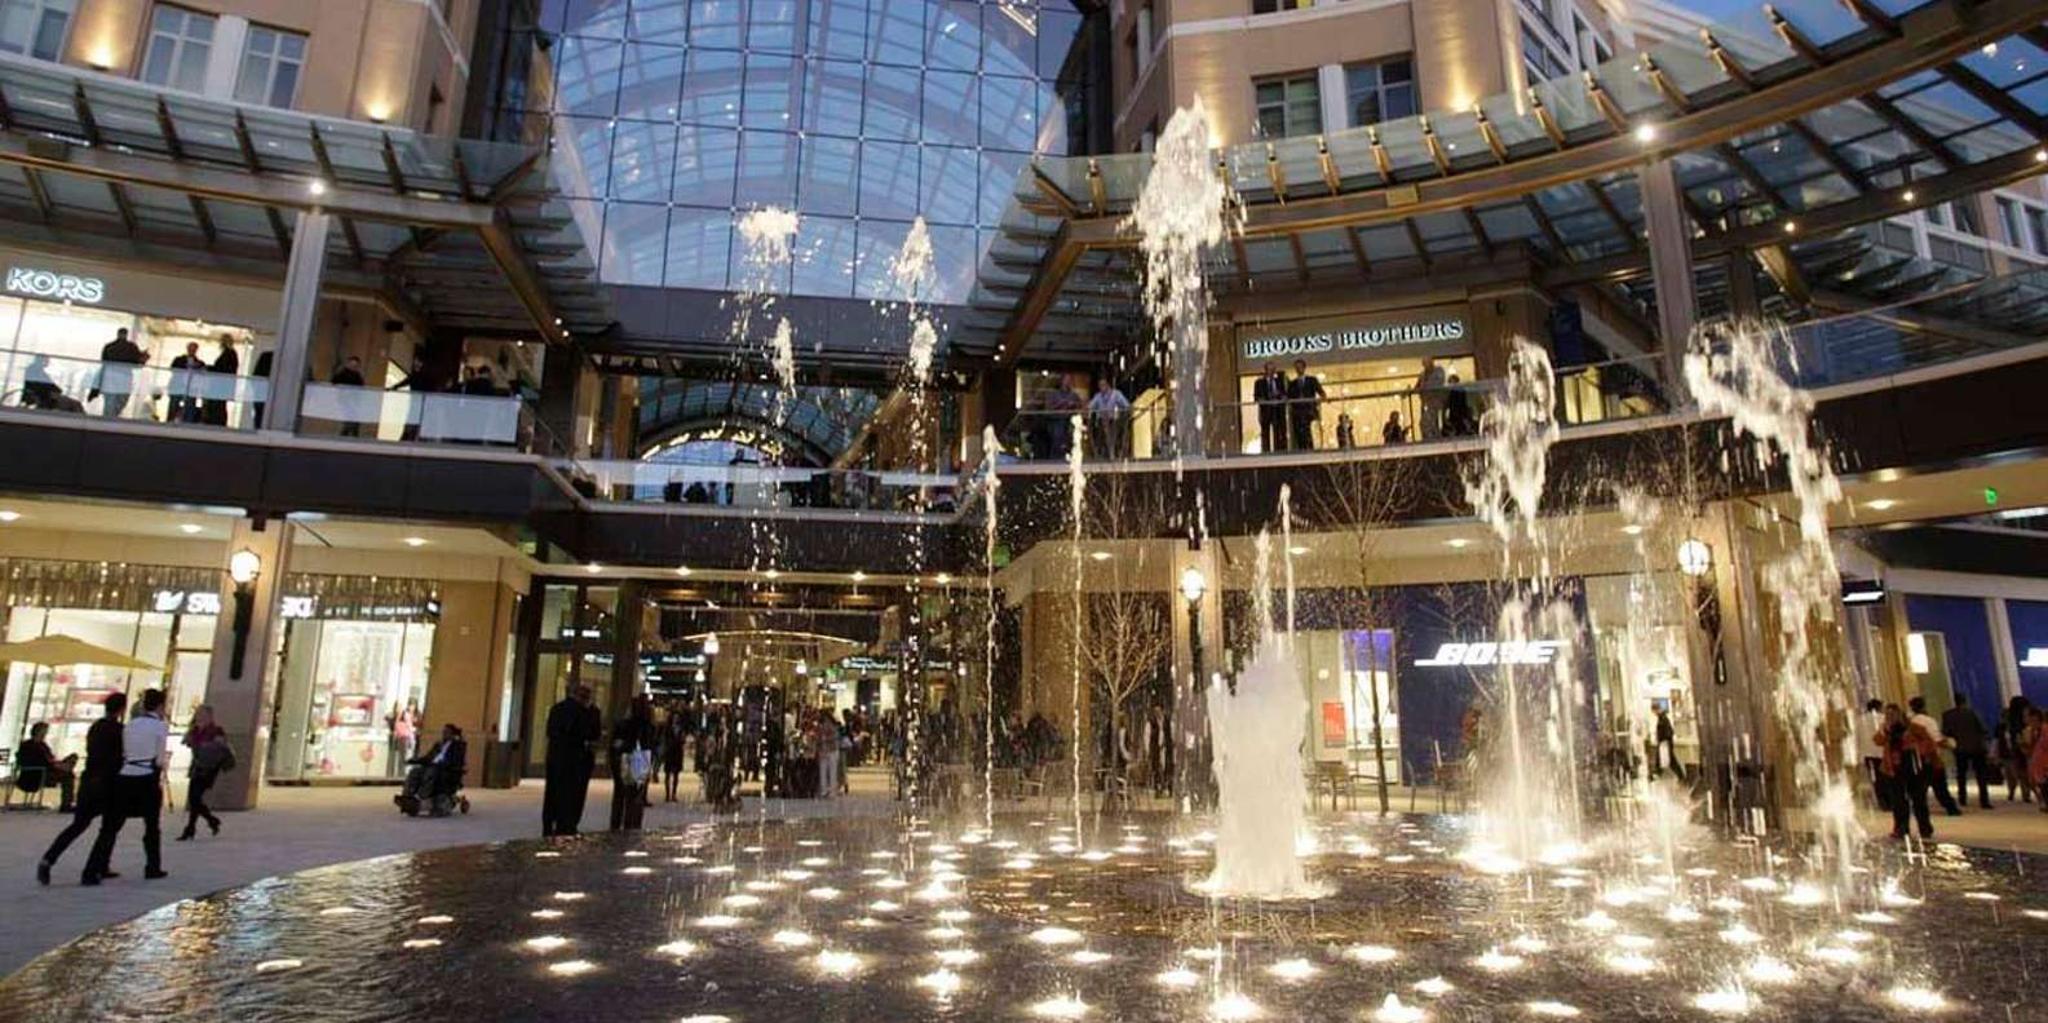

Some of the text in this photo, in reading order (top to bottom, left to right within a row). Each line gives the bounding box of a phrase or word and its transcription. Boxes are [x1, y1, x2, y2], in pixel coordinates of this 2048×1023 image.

[7, 267, 103, 303] KORS
[1245, 320, 1464, 357] BROOKS BROTHERS
[1414, 639, 1571, 666] BOSE
